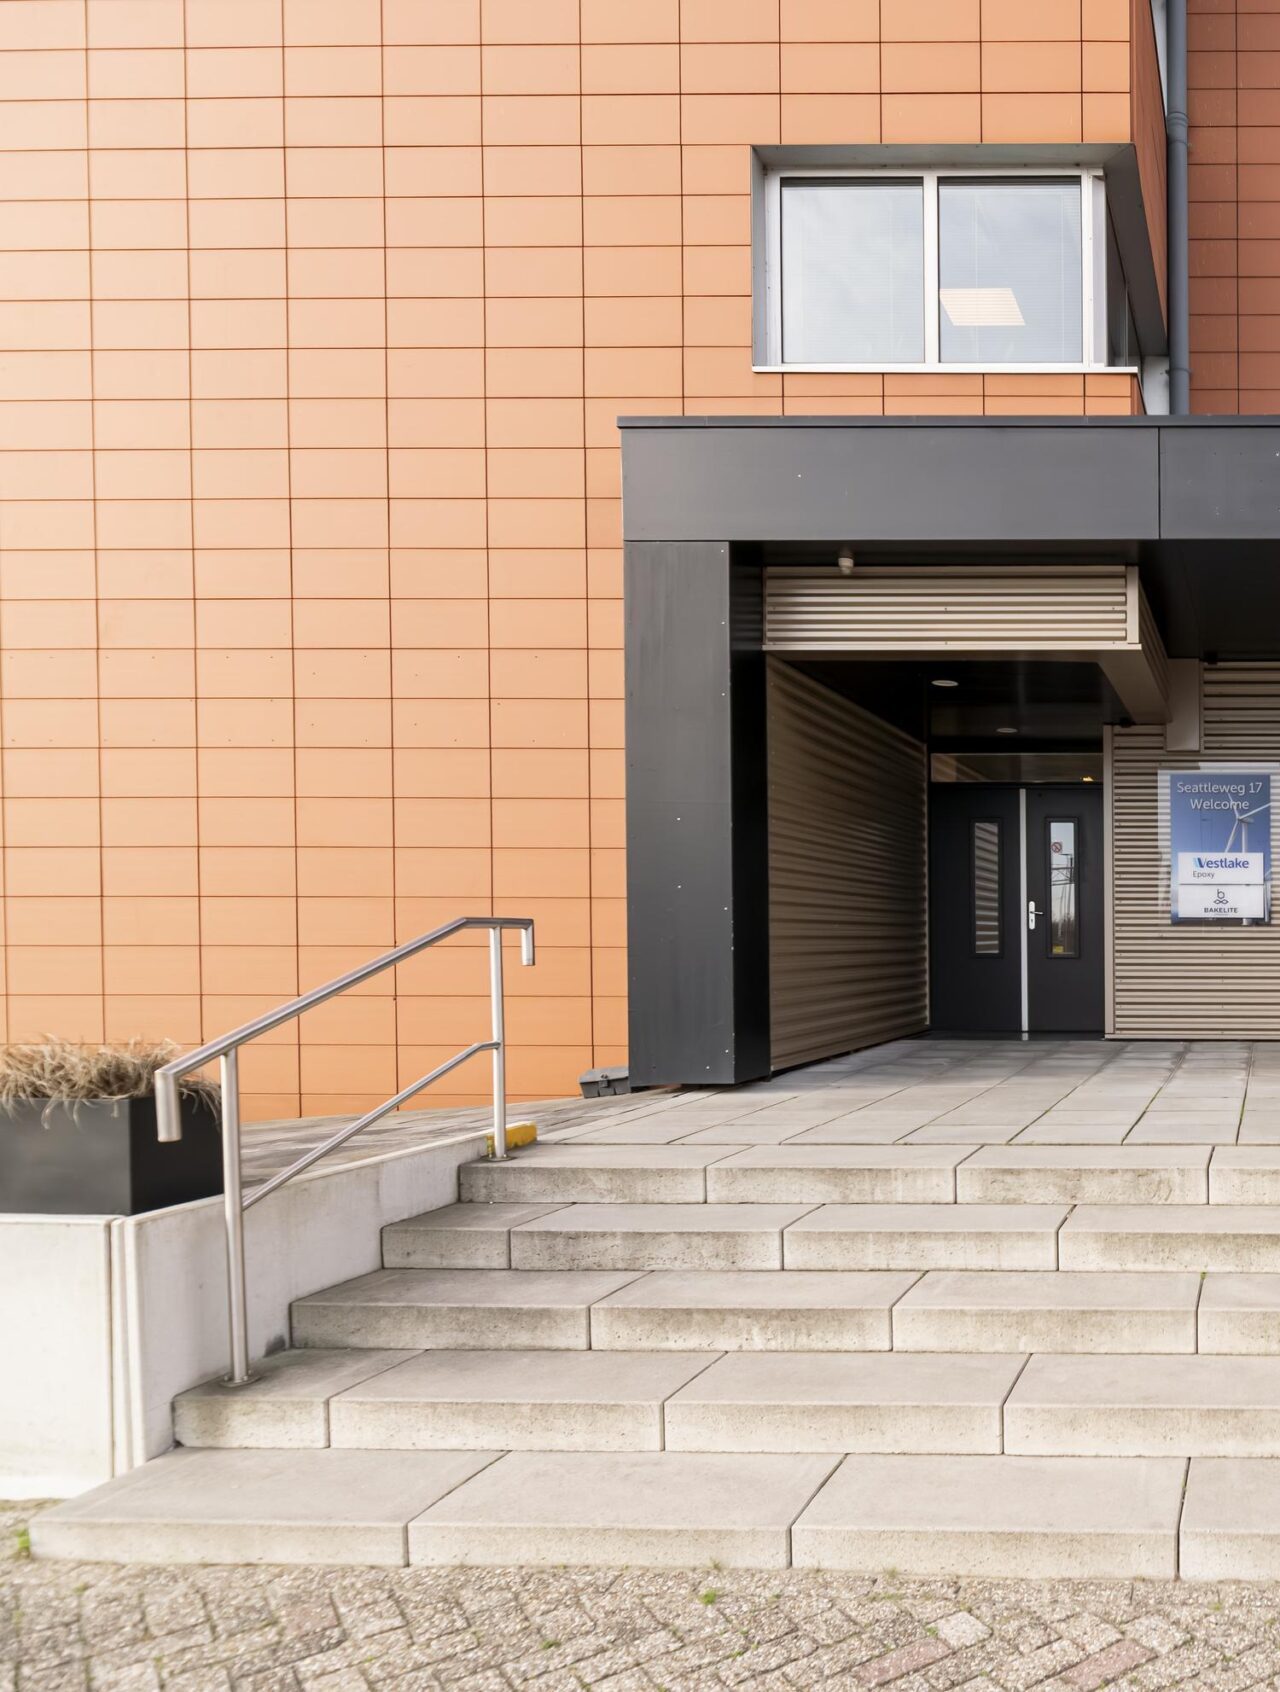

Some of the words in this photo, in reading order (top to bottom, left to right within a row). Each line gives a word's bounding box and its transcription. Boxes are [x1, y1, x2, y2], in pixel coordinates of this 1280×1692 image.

[1177, 782, 1246, 796] Seattleweg
[1249, 782, 1263, 793] 17
[1190, 799, 1249, 810] Welcome
[1193, 857, 1249, 869] Westlake
[1193, 871, 1215, 879] Epoxy
